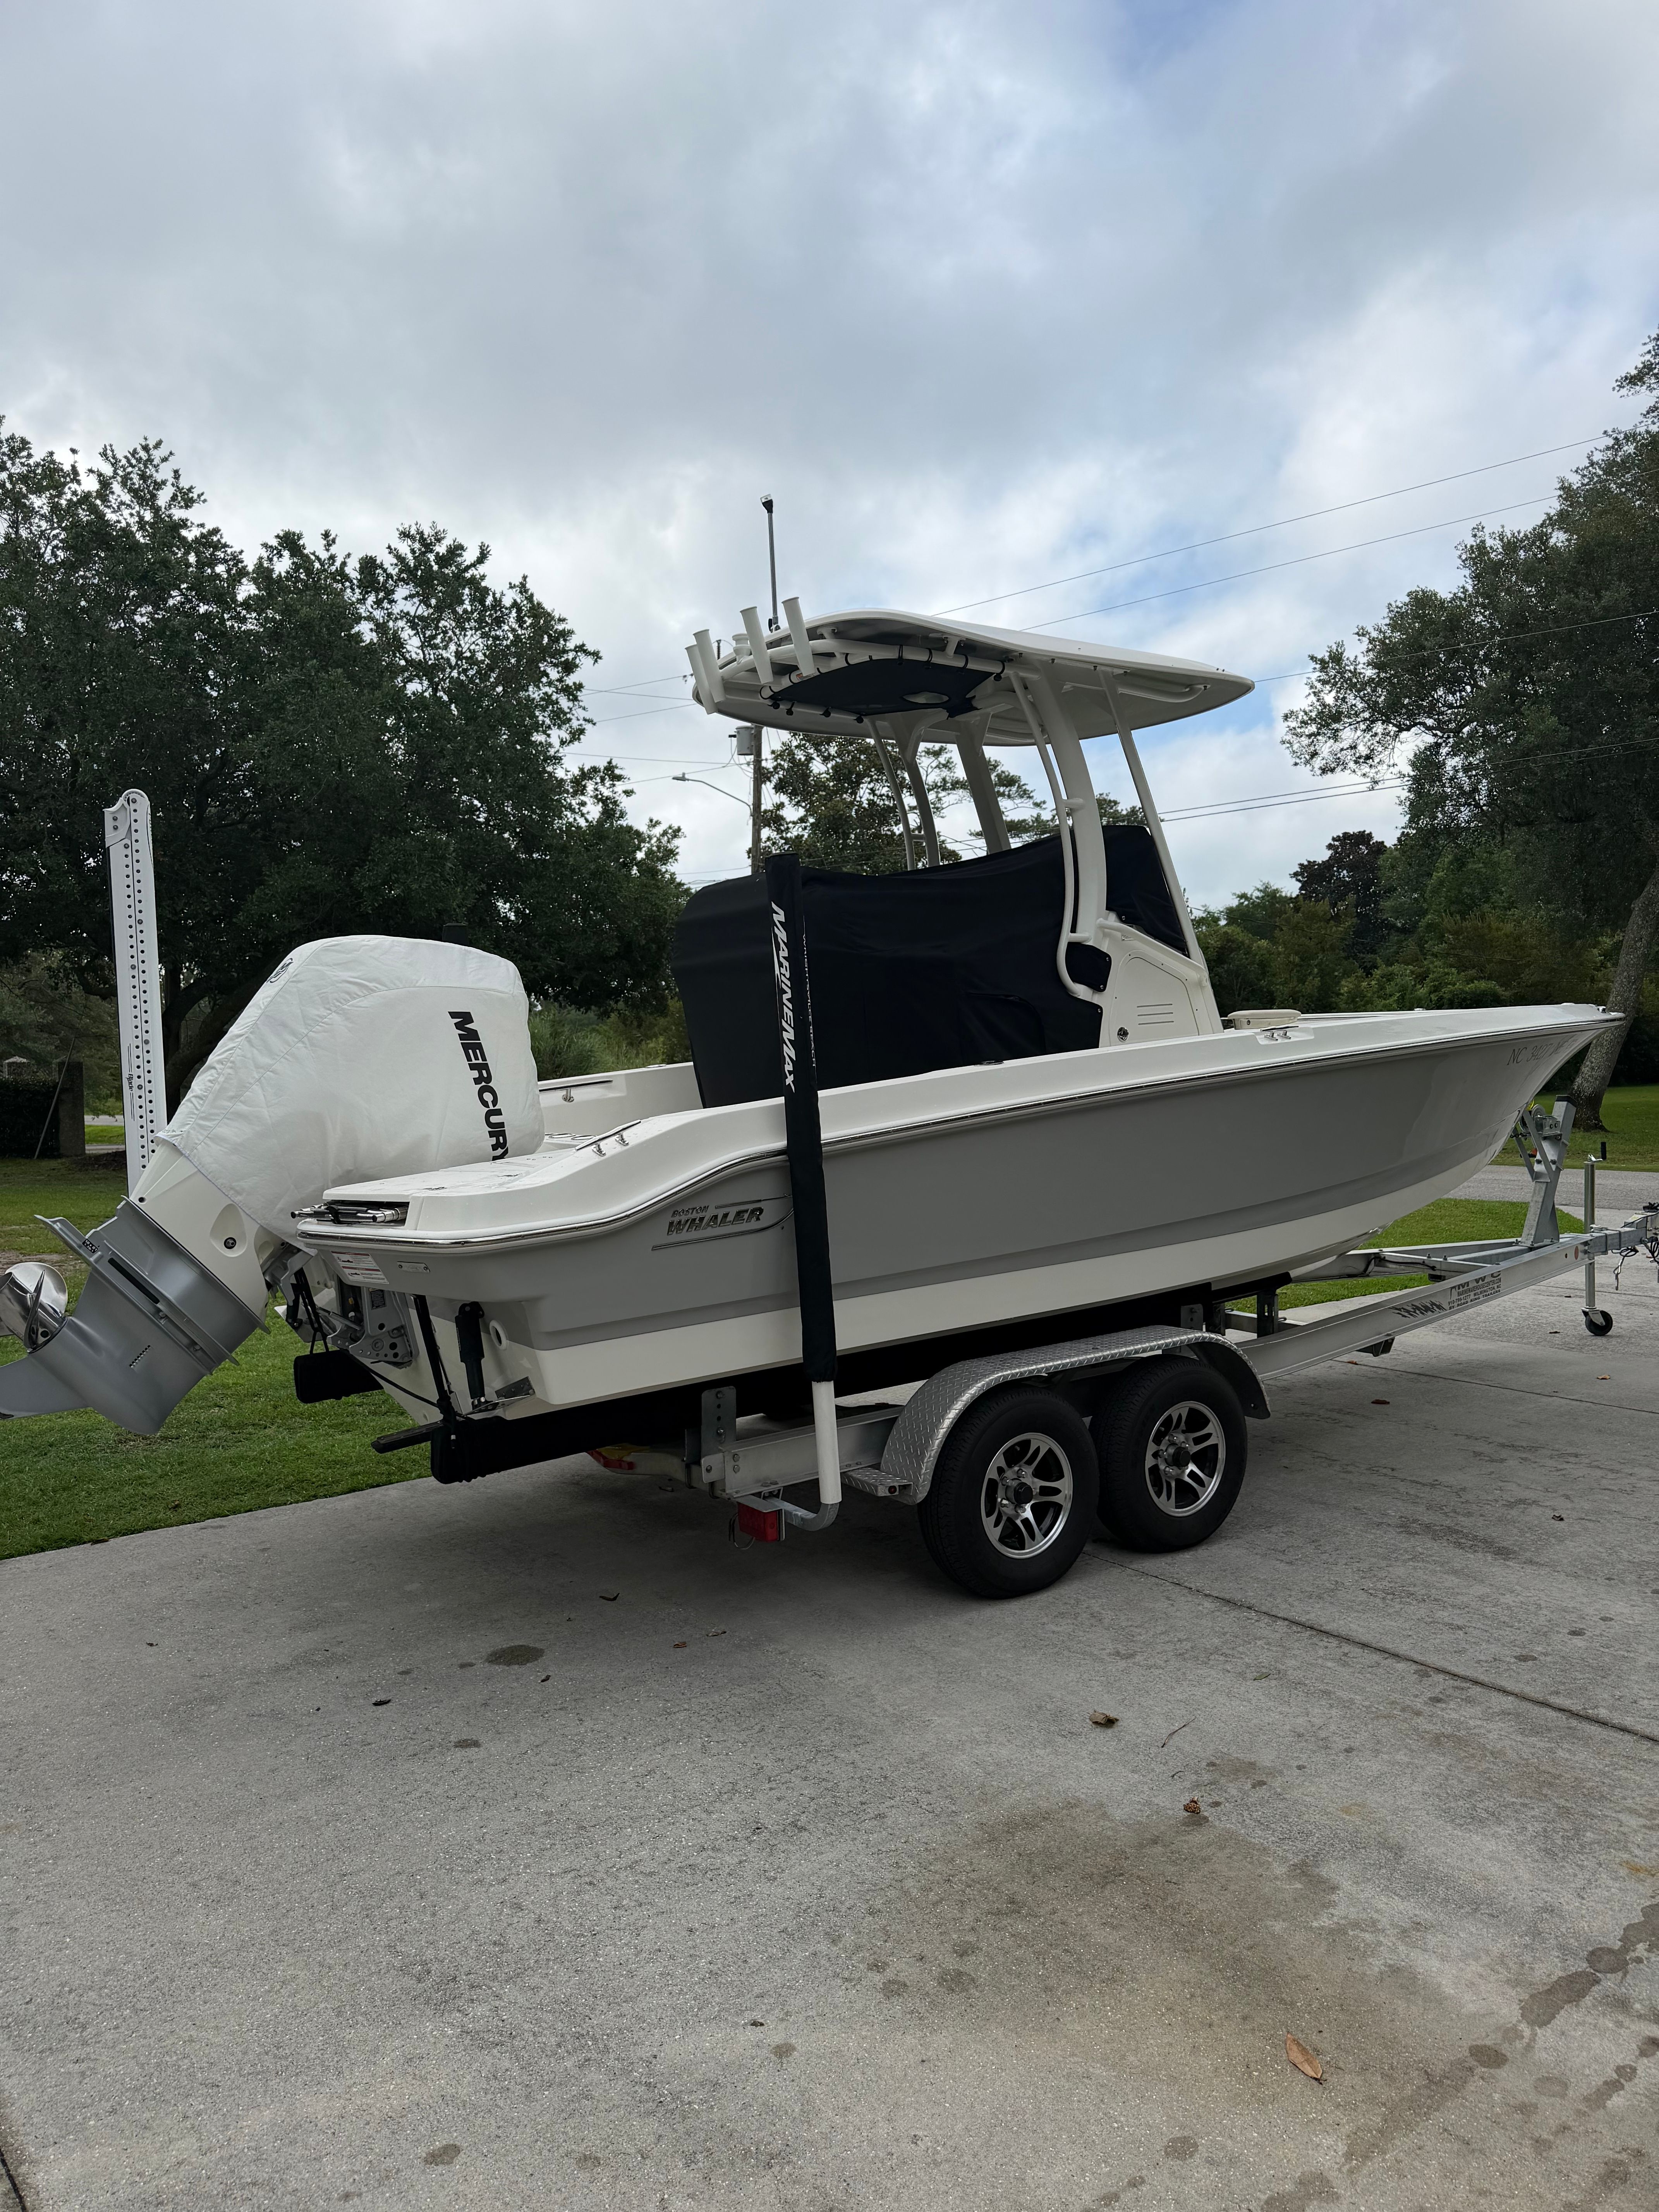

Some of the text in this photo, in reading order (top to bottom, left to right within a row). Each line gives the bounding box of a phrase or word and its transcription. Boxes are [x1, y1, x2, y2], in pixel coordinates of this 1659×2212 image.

[771, 901, 796, 1093] MARINEMAX
[1507, 1047, 1527, 1065] NC
[448, 1011, 508, 1161] MERCURY
[667, 1207, 764, 1236] WHALER
[671, 1205, 709, 1218] BOSTON
[1482, 1289, 1501, 1298] TRAILERS
